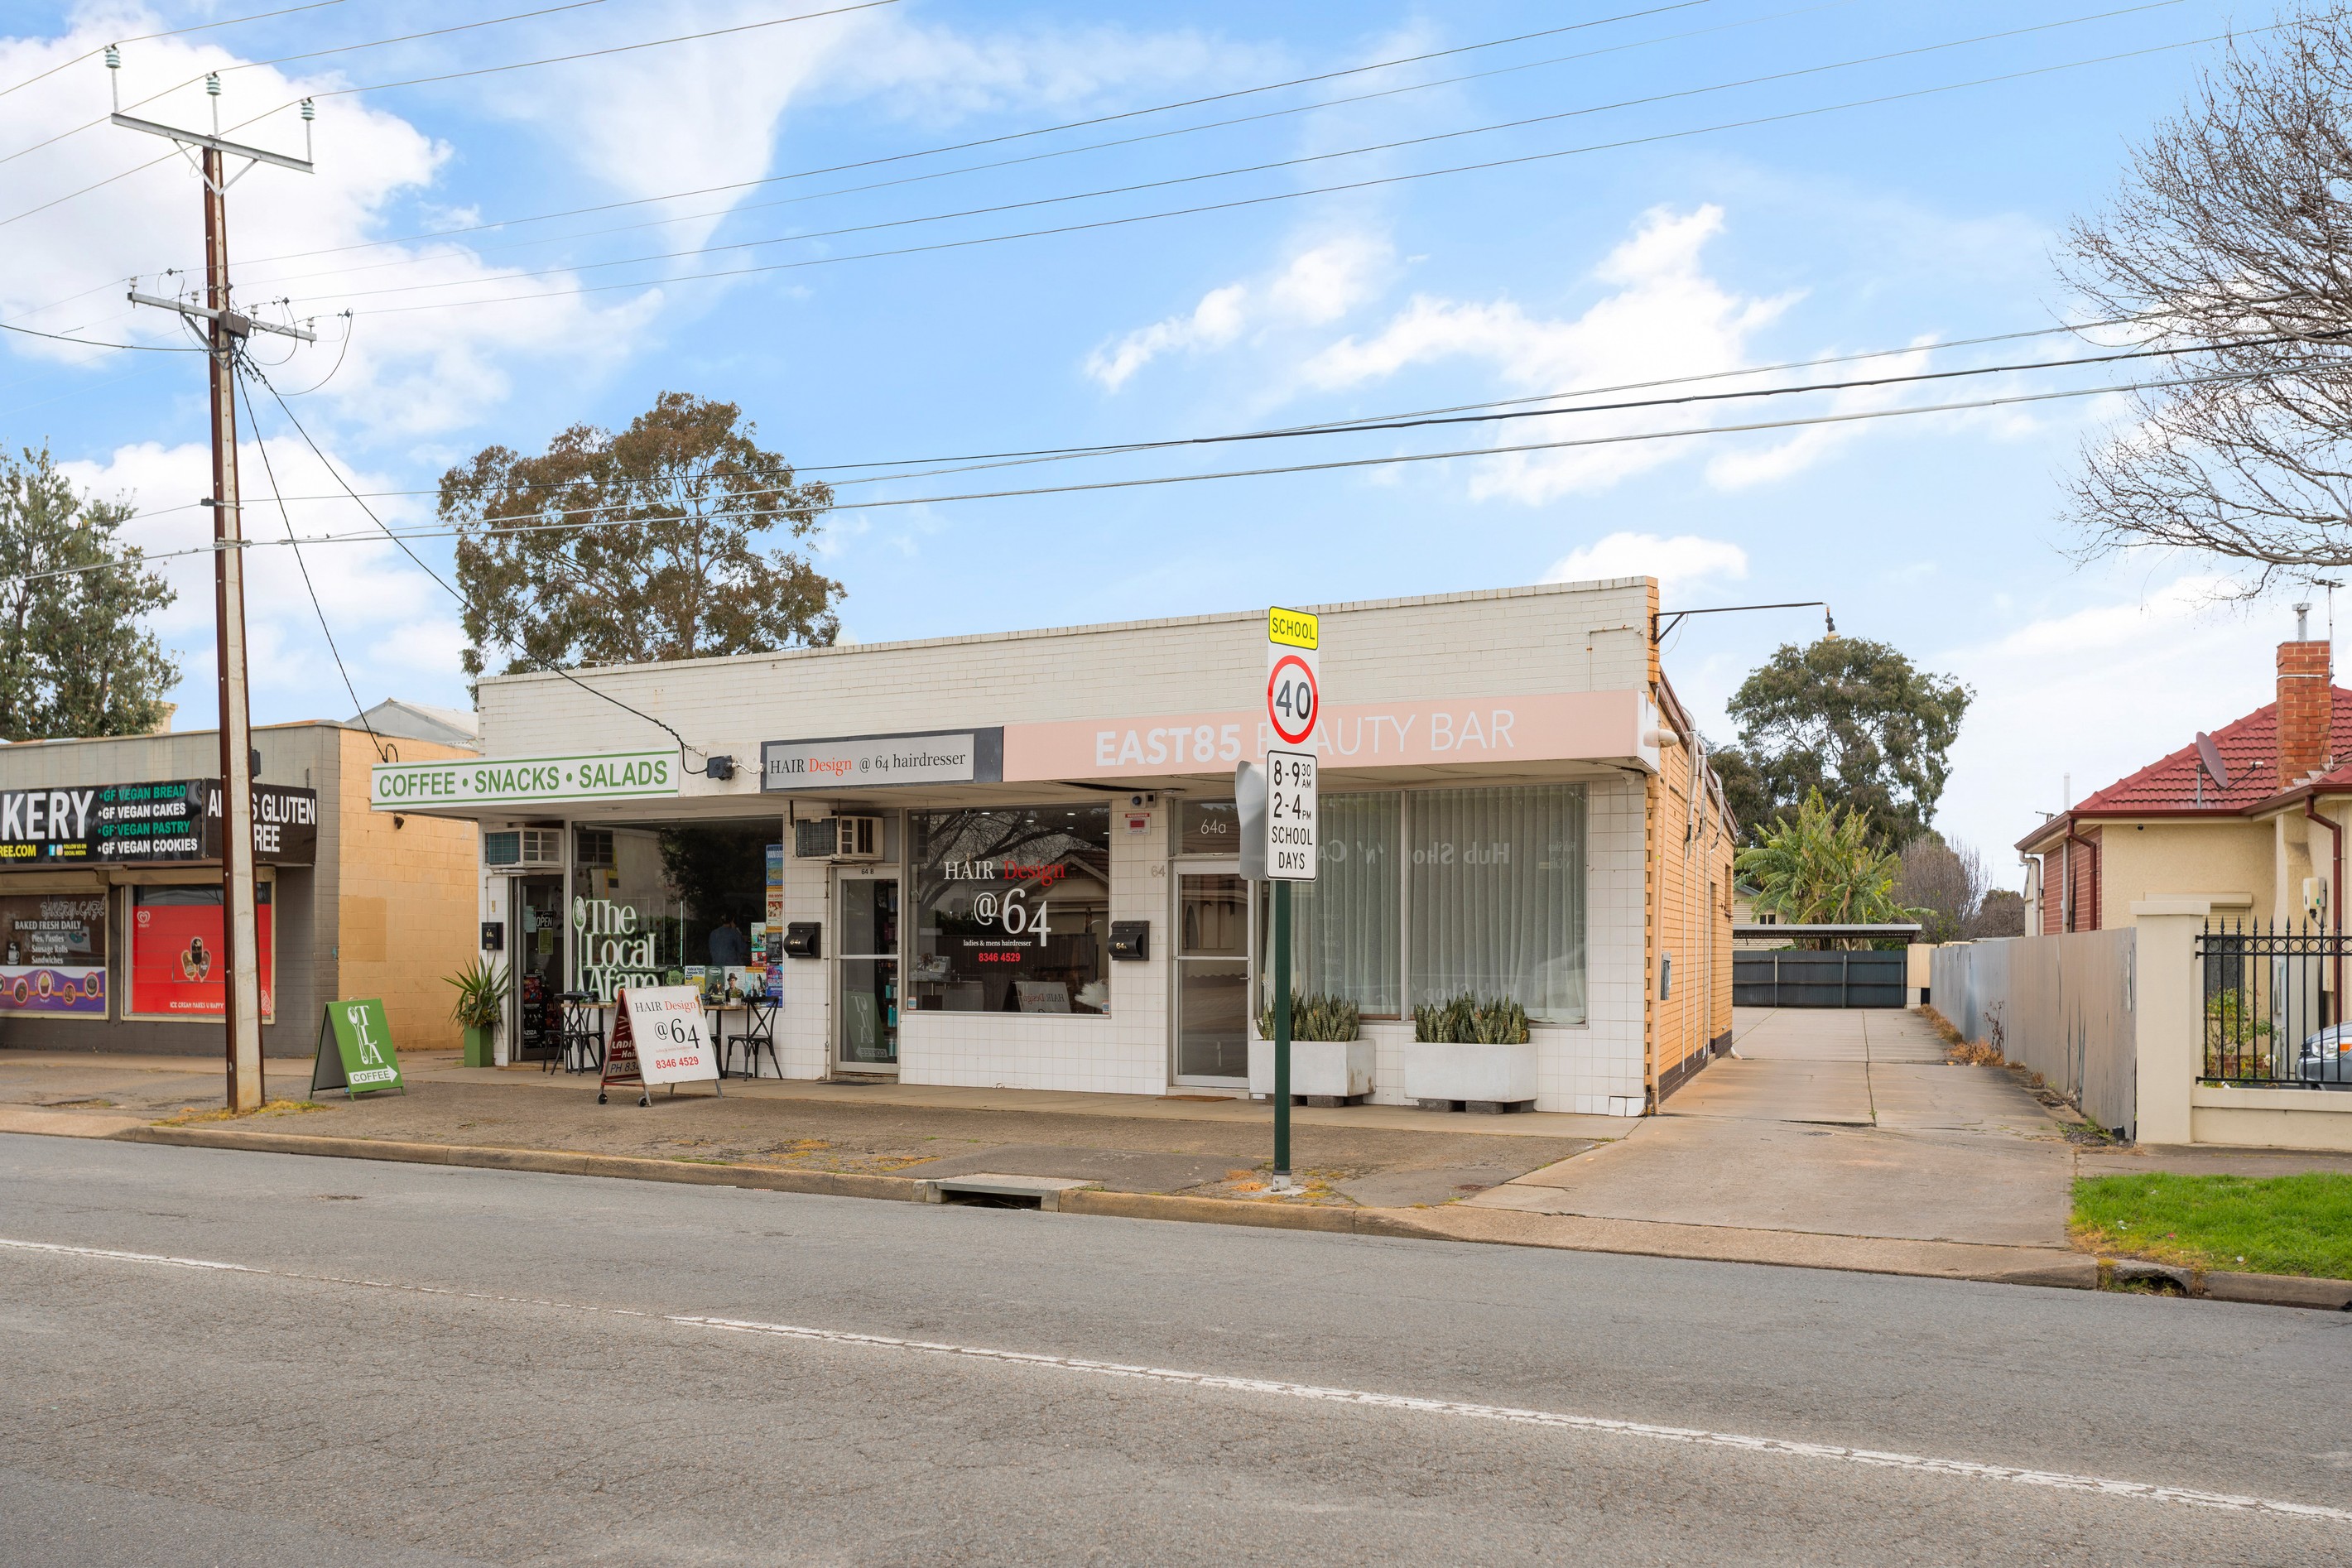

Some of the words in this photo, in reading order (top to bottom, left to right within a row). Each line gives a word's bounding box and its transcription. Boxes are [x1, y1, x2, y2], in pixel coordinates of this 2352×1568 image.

[1272, 617, 1315, 640] SCHOOL
[1275, 680, 1311, 719] 40
[1095, 724, 1242, 767] EAST85
[1258, 714, 1416, 759] AUTY
[1431, 709, 1515, 751] BAR
[770, 758, 805, 774] HAIR
[809, 757, 853, 776] Design
[859, 758, 870, 773] @
[875, 755, 889, 772] 64
[893, 752, 966, 768] hairdresser
[1301, 763, 1311, 777] 30
[379, 772, 455, 798] COFFEE
[474, 766, 560, 793] SNACKS
[579, 760, 668, 788] SALADS
[1301, 778, 1311, 788] AM
[118, 786, 151, 801] VEGAN
[153, 784, 186, 799] BREAD
[2, 790, 95, 841] KERY
[118, 804, 150, 819] VEGAN
[152, 802, 186, 817] CAKES
[262, 793, 315, 825] GLUTEN
[1301, 810, 1311, 820] PM
[117, 822, 150, 837] VEGAN
[152, 820, 190, 835] PASTRY
[1200, 819, 1226, 835] 64a
[253, 824, 281, 853] REE
[1272, 825, 1313, 846] SCHOOL
[117, 839, 150, 854] VEGAN
[152, 838, 198, 853] COOKIES
[1278, 851, 1306, 870] DAYS
[944, 861, 995, 879] HAIR
[1003, 860, 1065, 886] Design
[1151, 865, 1166, 878] 64
[15, 920, 37, 930] BAKED
[39, 920, 60, 930] FRESH
[60, 920, 82, 930] DAILY
[536, 916, 553, 927] OPEN
[585, 899, 637, 935] The
[46, 934, 65, 943] Pasties
[31, 945, 54, 955] Sausage
[55, 945, 68, 953] Rolls
[584, 932, 657, 969] Local
[978, 952, 998, 962] 8346
[1000, 952, 1021, 962] 4529
[31, 955, 64, 964] Sandwiches
[634, 1001, 662, 1012] HAIR
[664, 1000, 696, 1013] Design
[613, 1039, 635, 1049] LADI
[610, 1063, 623, 1074] PH
[656, 1059, 677, 1070] 8346
[678, 1056, 700, 1066] 4529
[354, 1070, 390, 1082] COFFEE
